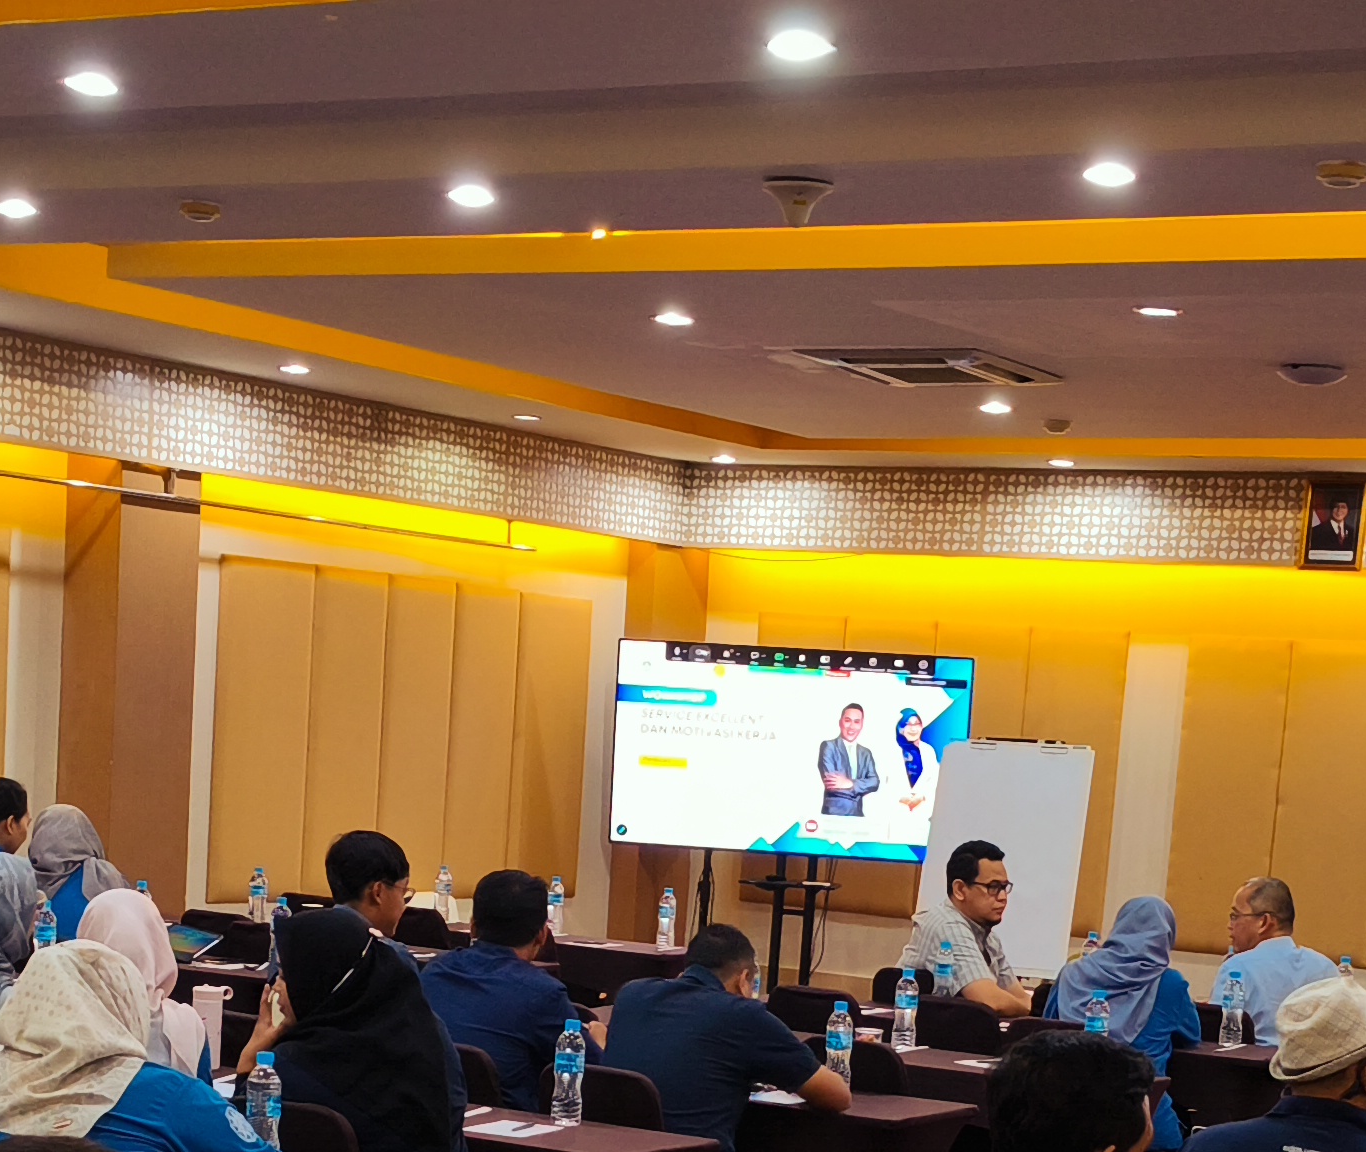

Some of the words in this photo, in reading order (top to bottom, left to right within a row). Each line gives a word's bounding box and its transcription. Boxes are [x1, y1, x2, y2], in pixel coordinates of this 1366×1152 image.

[641, 707, 693, 721] SERVICE
[640, 723, 667, 735] DAN
[737, 730, 777, 741] KERJA
